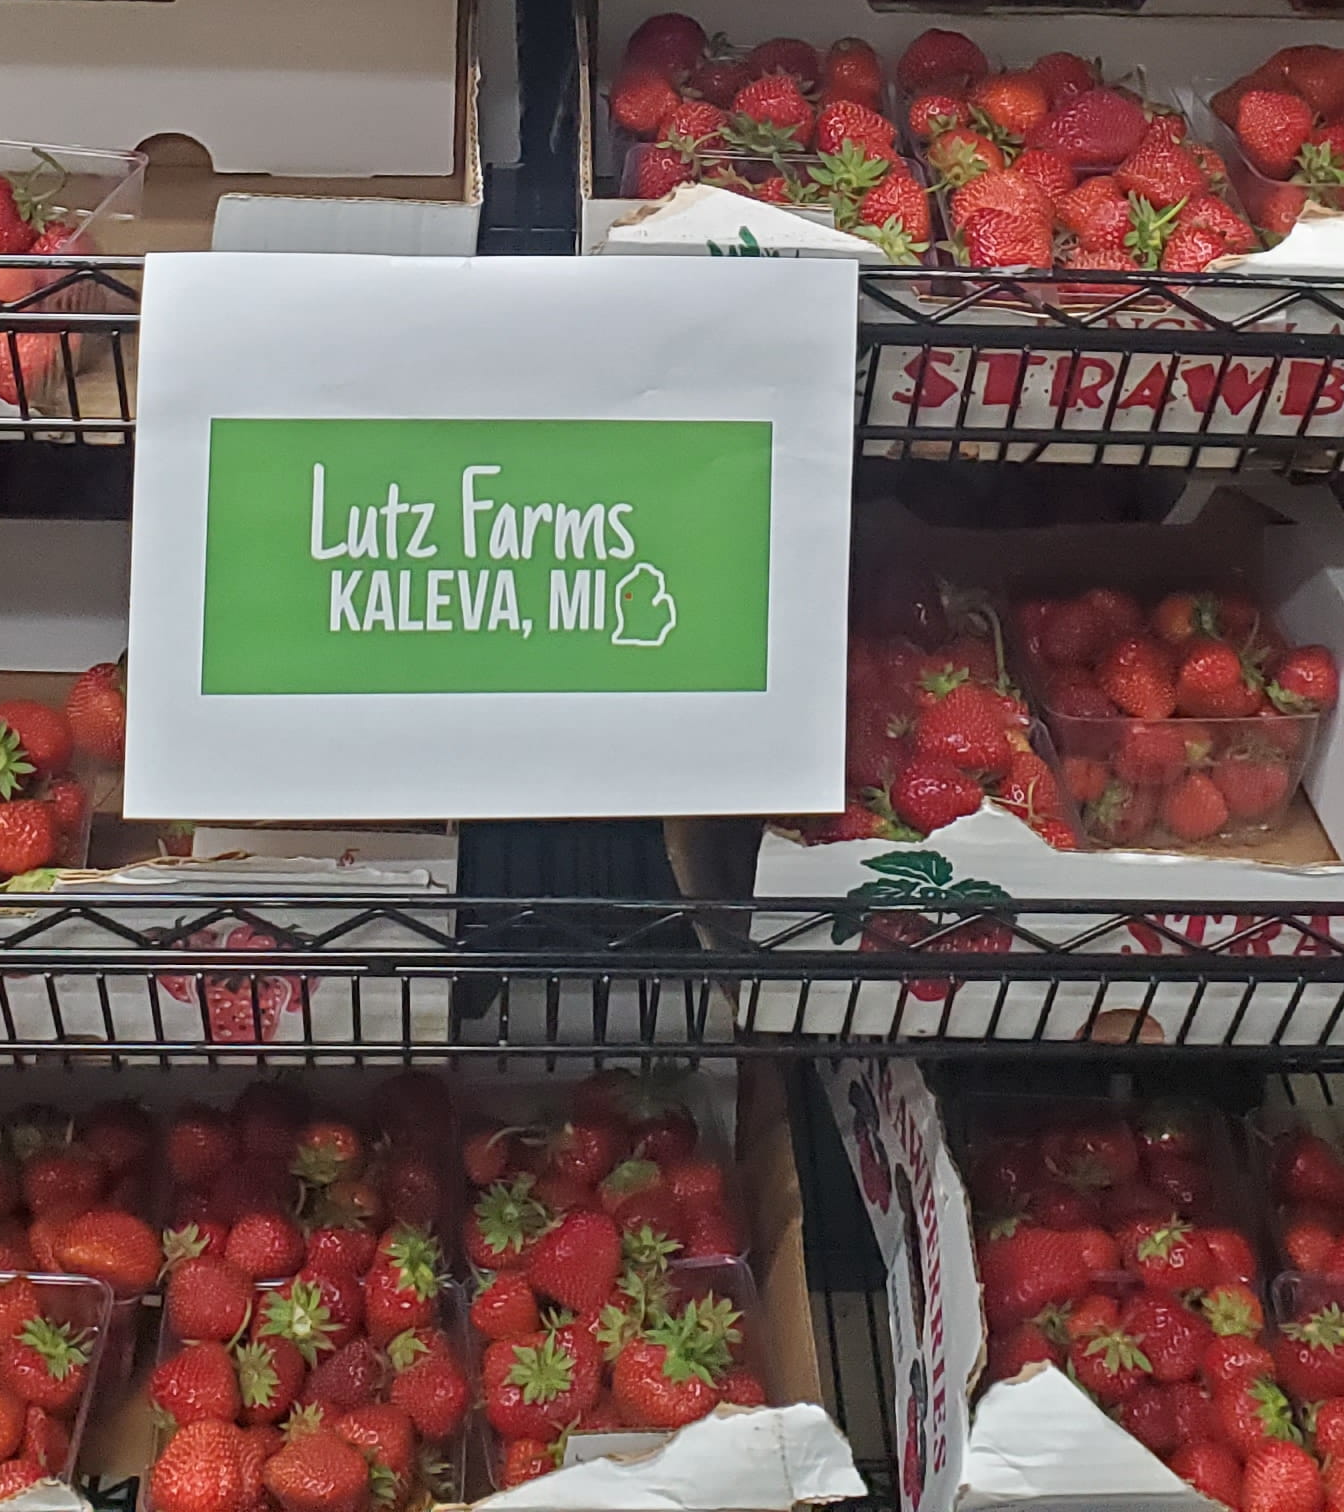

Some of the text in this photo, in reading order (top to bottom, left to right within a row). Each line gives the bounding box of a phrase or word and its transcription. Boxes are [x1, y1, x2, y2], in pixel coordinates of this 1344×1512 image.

[311, 462, 635, 560] Lutz Farms
[329, 569, 606, 639] KALEVA, MI
